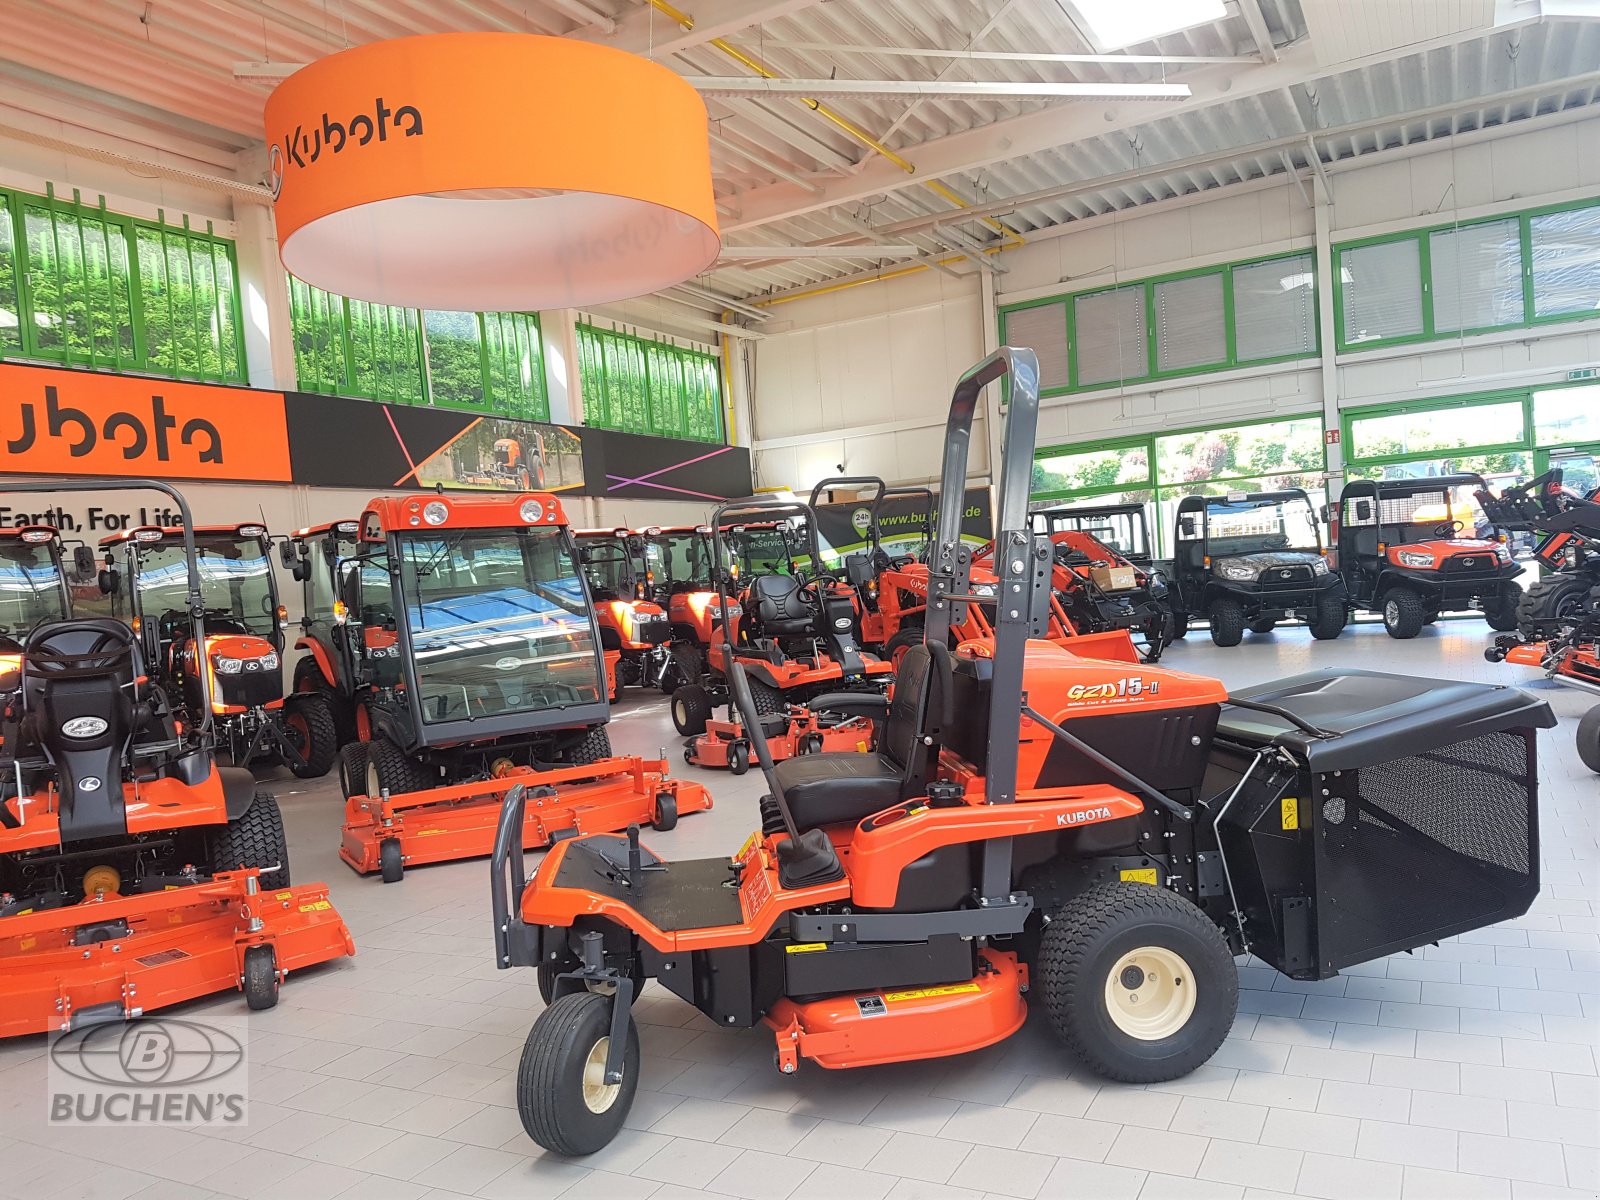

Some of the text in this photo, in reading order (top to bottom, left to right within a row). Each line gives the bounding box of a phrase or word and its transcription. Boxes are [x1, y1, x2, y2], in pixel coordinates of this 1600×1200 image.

[285, 97, 423, 169] Kubota
[6, 385, 223, 464] ubota
[0, 506, 183, 532] Earth, For Life
[880, 505, 981, 526] www.buh.de
[1056, 807, 1111, 826] KUBOTA
